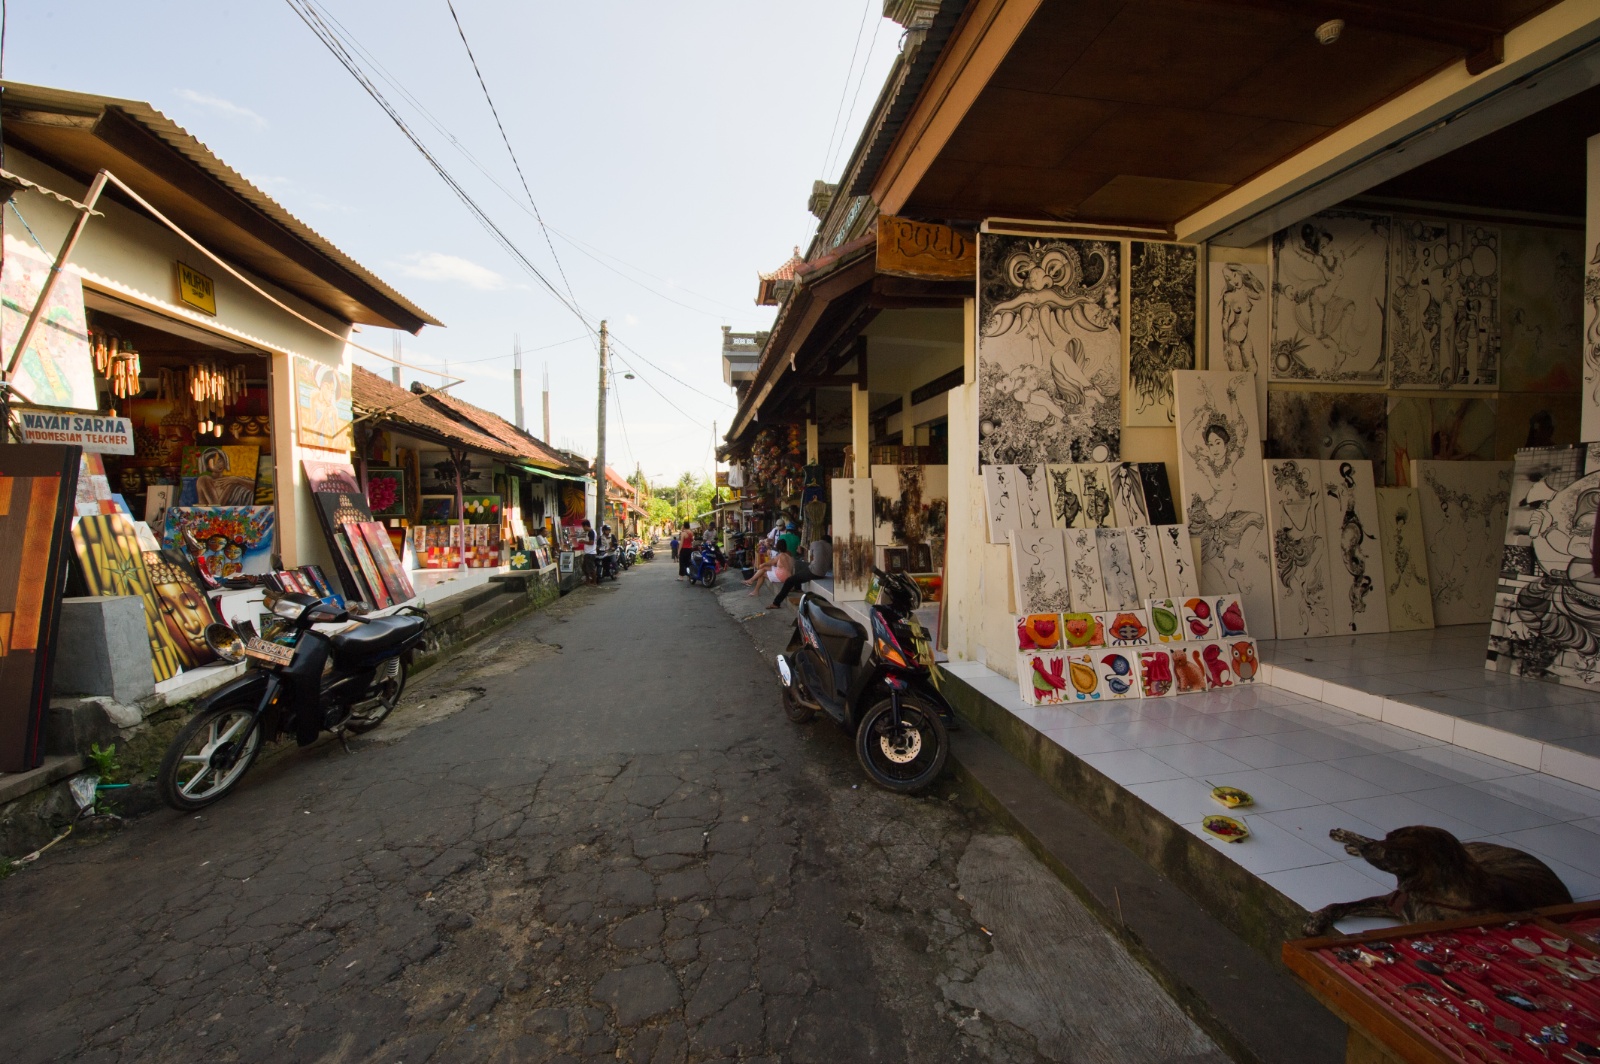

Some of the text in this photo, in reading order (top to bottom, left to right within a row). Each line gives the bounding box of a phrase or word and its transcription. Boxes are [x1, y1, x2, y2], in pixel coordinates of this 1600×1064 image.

[182, 267, 211, 296] MURNI
[23, 414, 126, 433] WAYAN SARNA
[25, 430, 128, 445] INDONESIAN TEACHER
